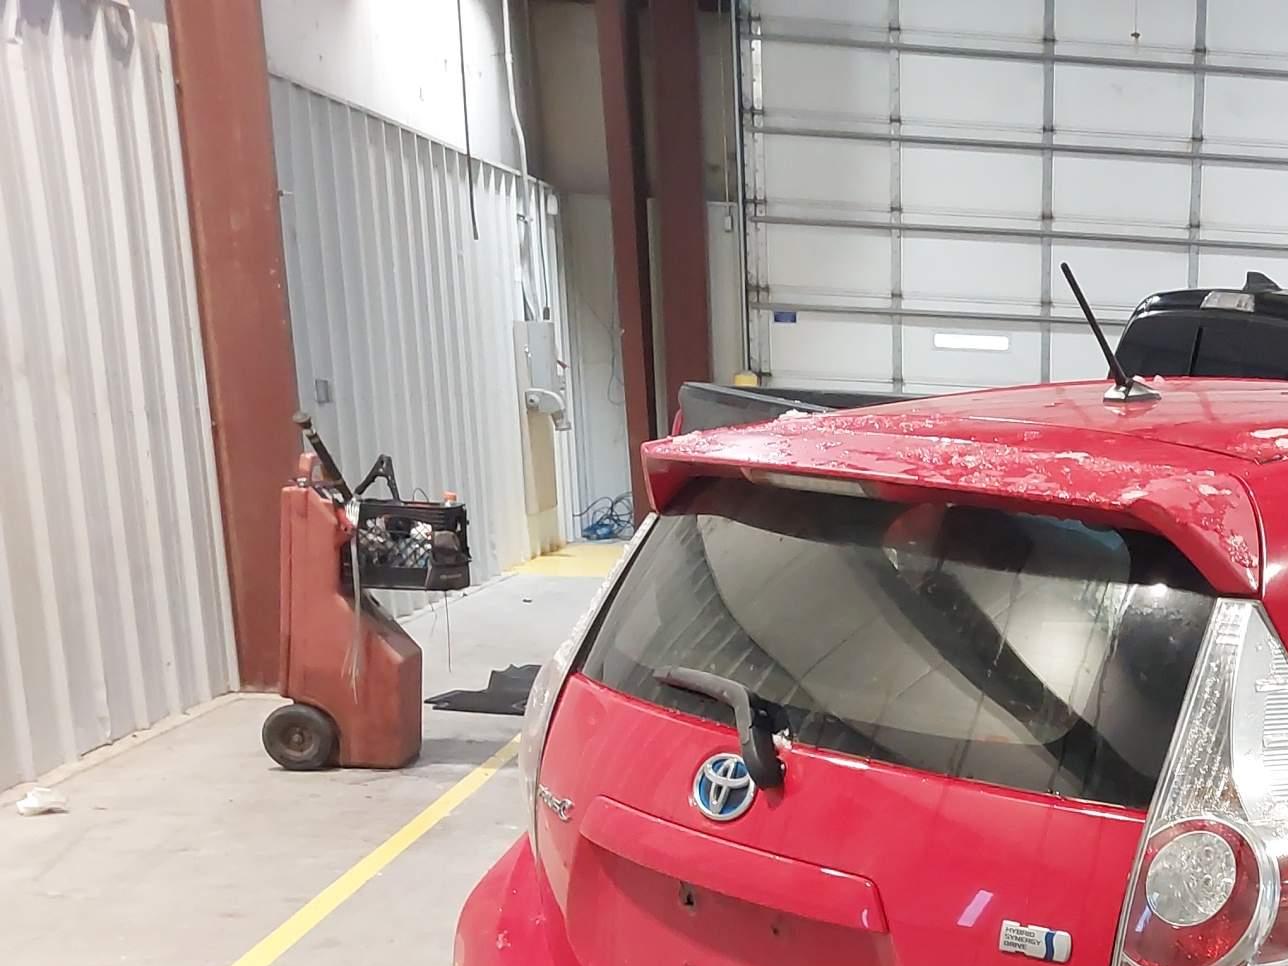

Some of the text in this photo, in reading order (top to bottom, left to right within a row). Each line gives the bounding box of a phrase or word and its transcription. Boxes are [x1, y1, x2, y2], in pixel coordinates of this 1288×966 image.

[1005, 926, 1036, 938] HYBRID
[1003, 940, 1026, 950] DRIVE
[1004, 933, 1041, 946] SYNERGY
